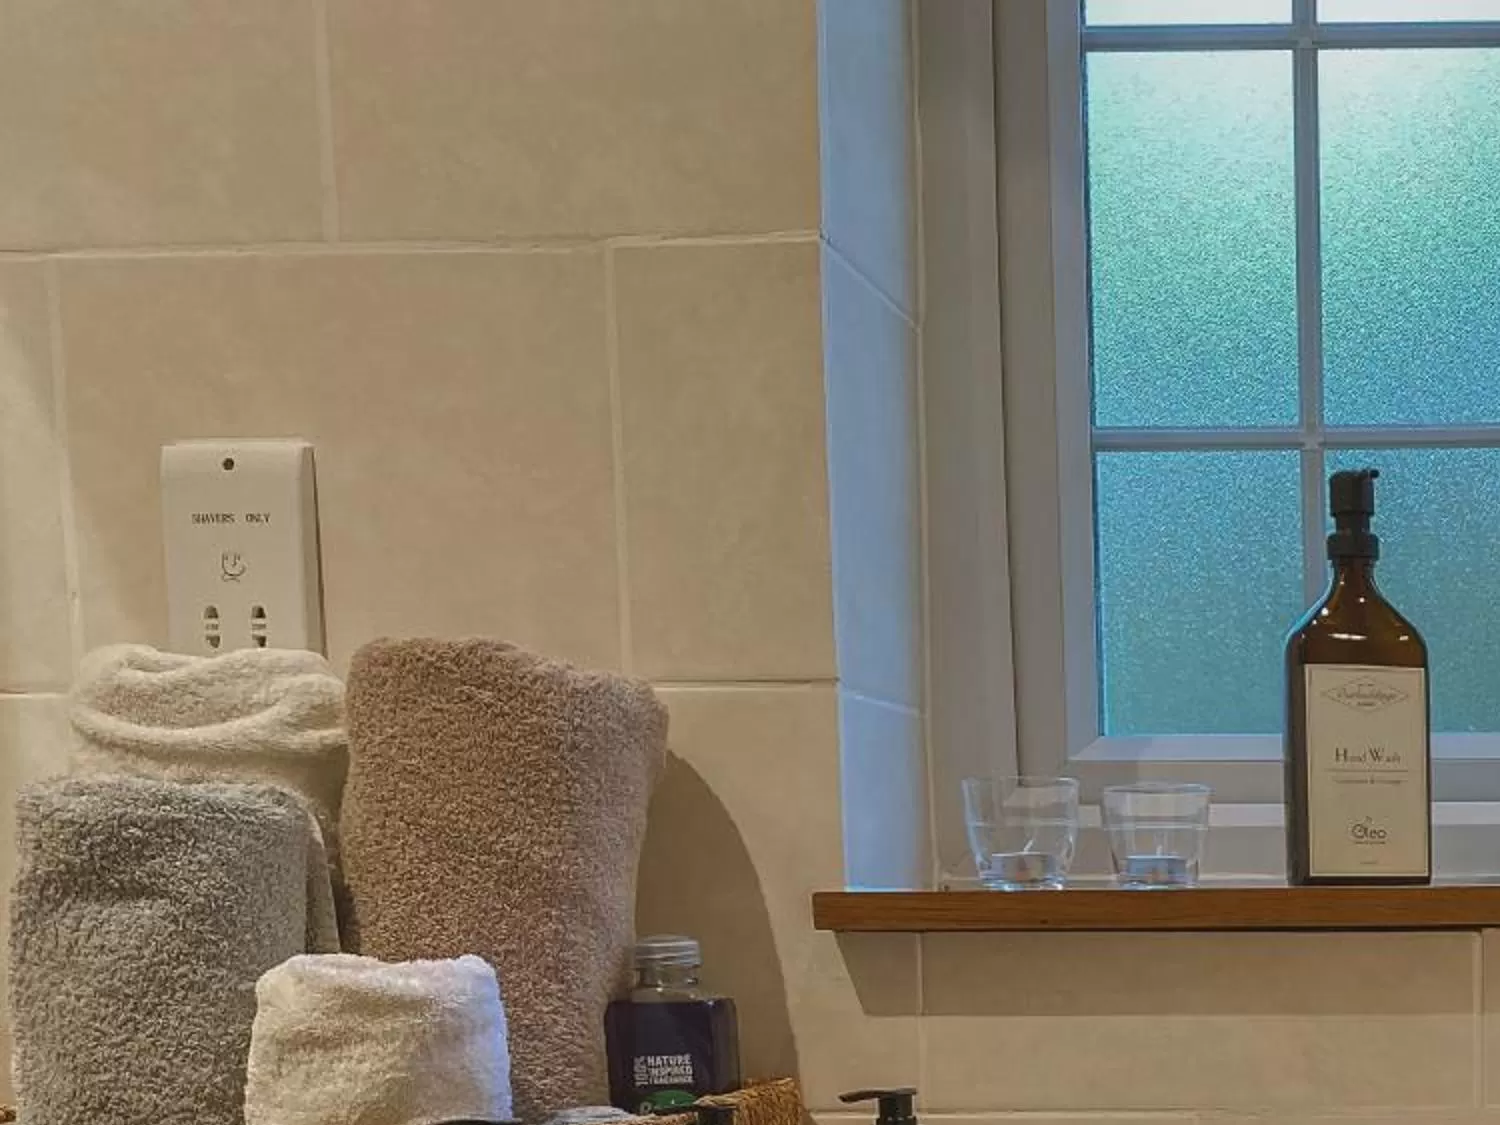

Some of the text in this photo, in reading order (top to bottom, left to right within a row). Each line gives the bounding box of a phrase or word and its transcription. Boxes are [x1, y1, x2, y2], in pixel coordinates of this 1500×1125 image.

[191, 512, 271, 524] SHAVERS ONLY
[647, 1053, 692, 1066] NATURE
[648, 1065, 693, 1076] INSPIRED
